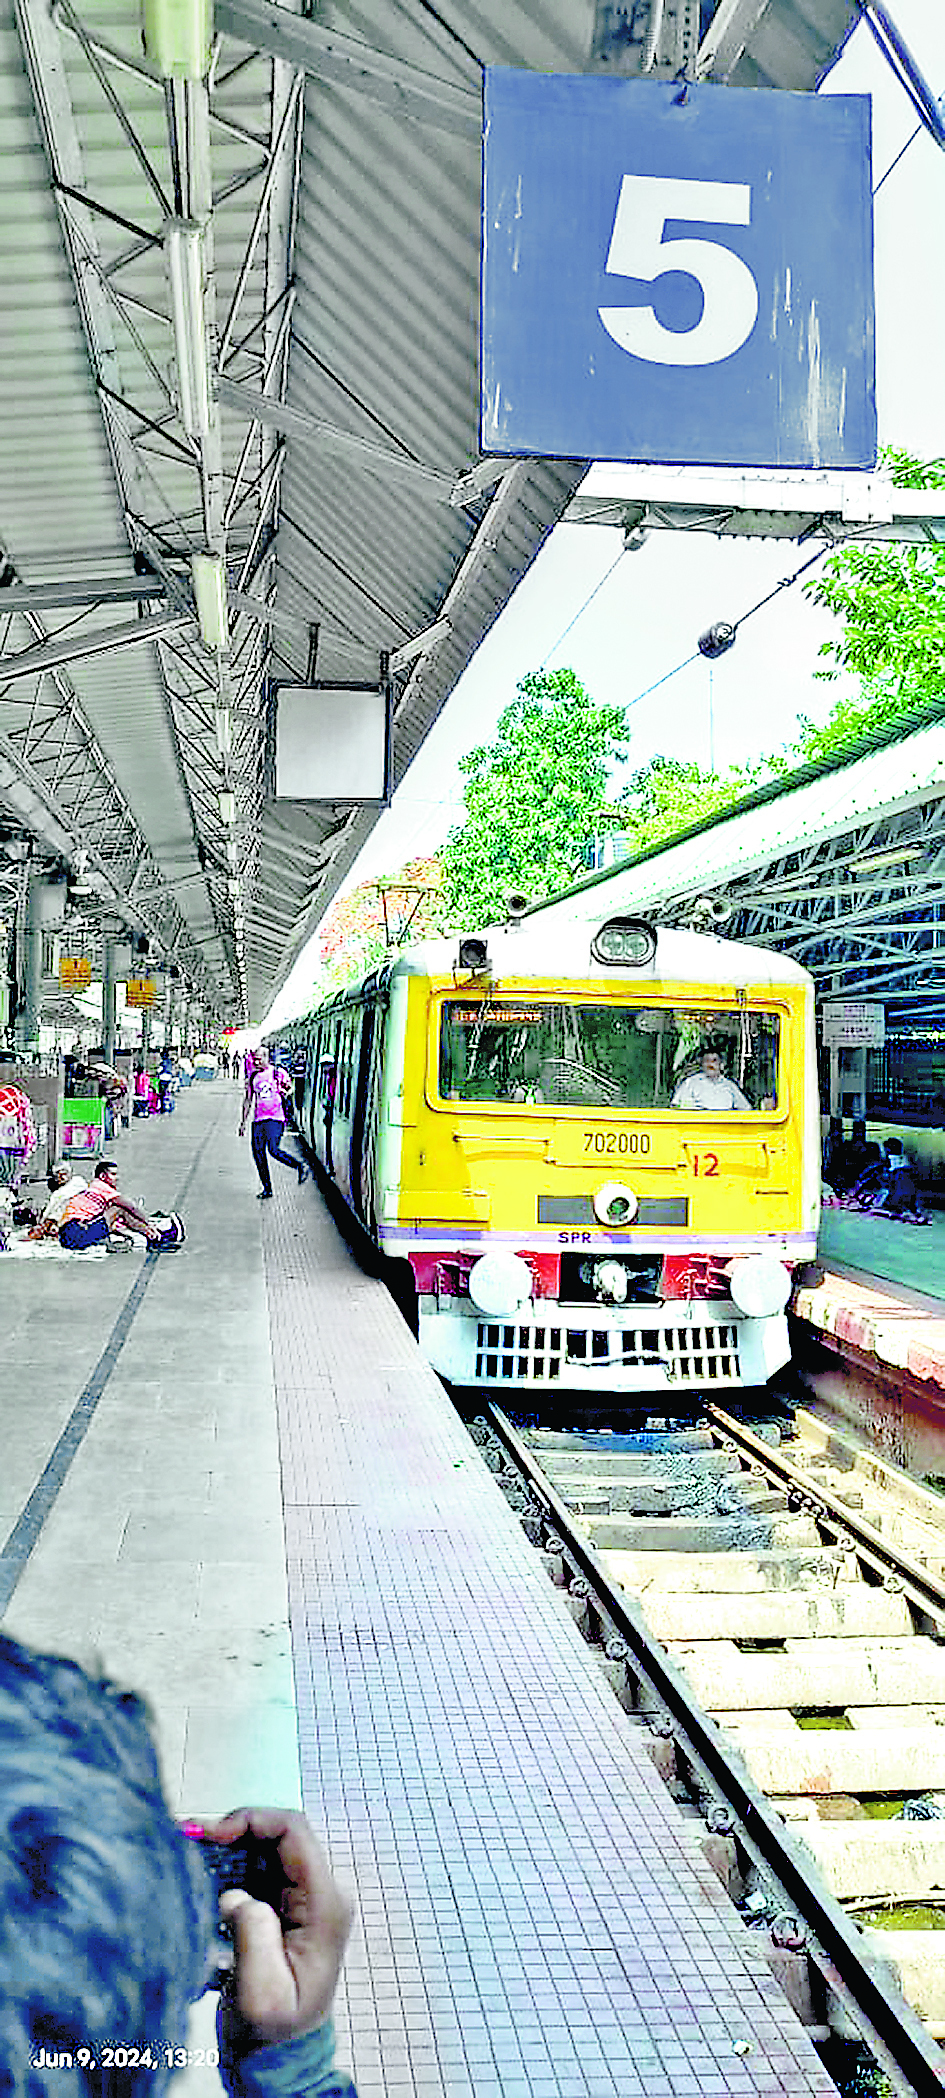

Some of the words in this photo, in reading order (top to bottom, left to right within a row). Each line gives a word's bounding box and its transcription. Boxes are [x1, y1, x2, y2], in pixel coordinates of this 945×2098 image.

[598, 174, 758, 366] 5
[583, 1133, 650, 1154] 702000
[693, 1153, 720, 1177] 12
[557, 1231, 592, 1244] SPR
